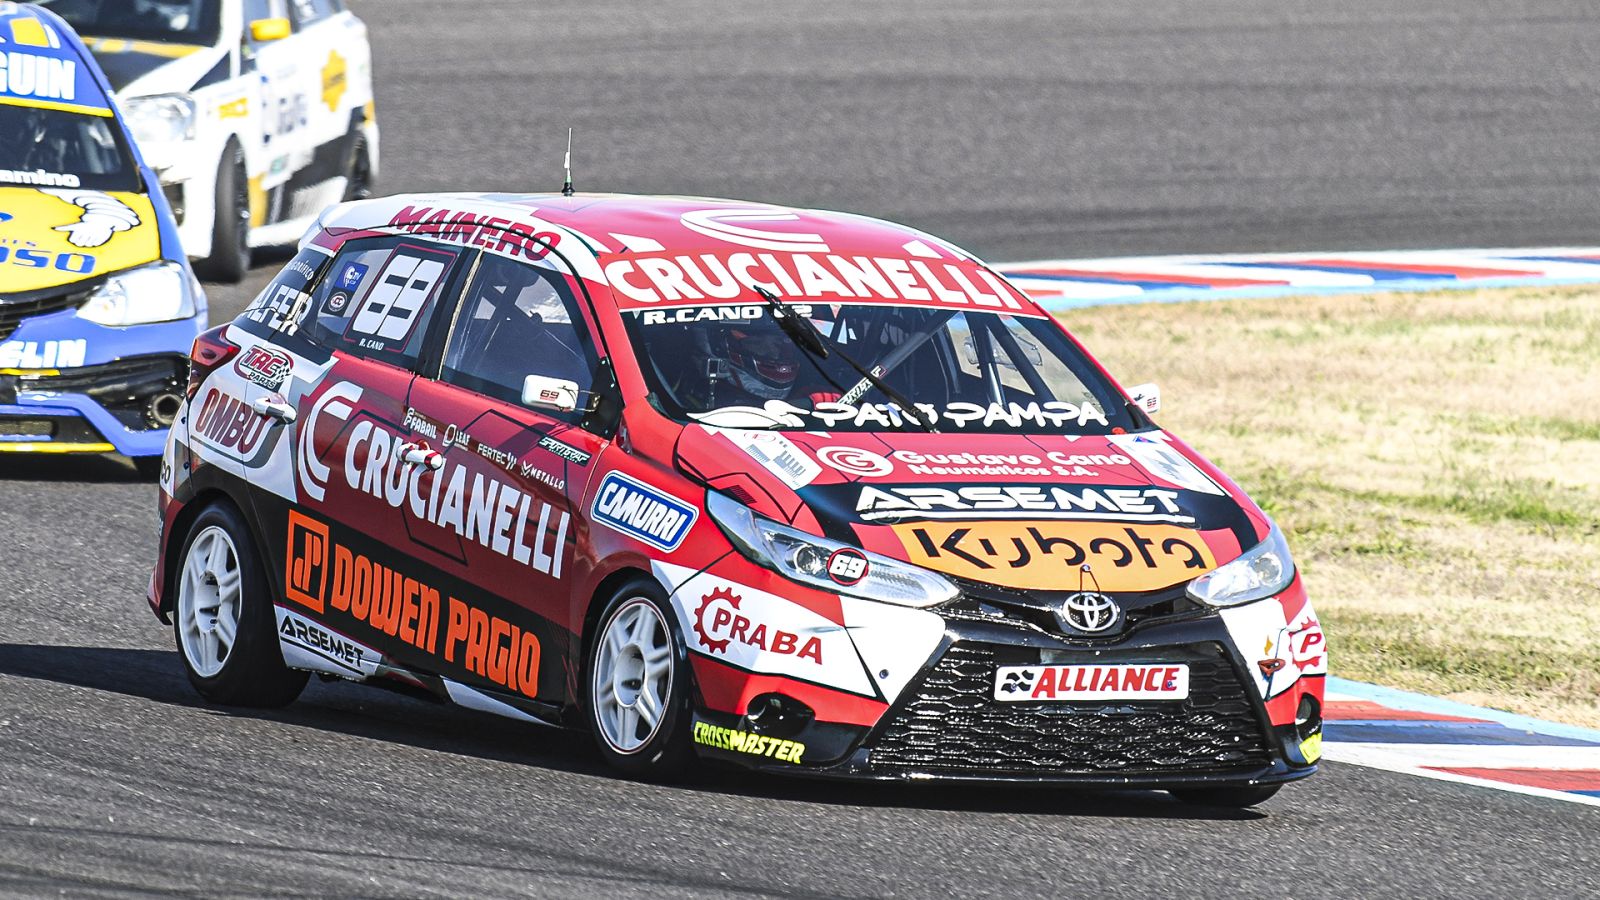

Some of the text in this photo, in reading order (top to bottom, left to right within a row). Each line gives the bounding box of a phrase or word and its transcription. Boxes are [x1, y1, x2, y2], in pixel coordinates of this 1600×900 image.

[388, 205, 562, 262] MAINERO
[0, 246, 96, 274] SO
[603, 251, 1022, 311] CRUCIANELLI
[352, 254, 445, 341] 69
[643, 305, 764, 326] R.CANO
[248, 371, 277, 390] PARTS
[540, 389, 560, 399] 69
[811, 401, 1109, 428] PATO PAMPA
[477, 443, 506, 465] FERTEC
[893, 449, 1132, 466] Gustavo Cano
[530, 468, 565, 490] METALLO
[907, 463, 1100, 478] Neumáticos S.A.
[344, 420, 571, 579] CRUCIANELLI
[598, 482, 689, 542] CAMURRI
[855, 485, 1180, 514] ARSEMET
[911, 526, 1207, 571] Kubota
[829, 553, 866, 580] 69
[330, 543, 541, 698] DOWEN PAGIO
[280, 615, 364, 667] ARSEMET
[712, 607, 823, 665] PRABA
[1300, 632, 1328, 654] P
[1031, 667, 1179, 699] ALLIANCE
[694, 721, 806, 764] CROSSMASTER
